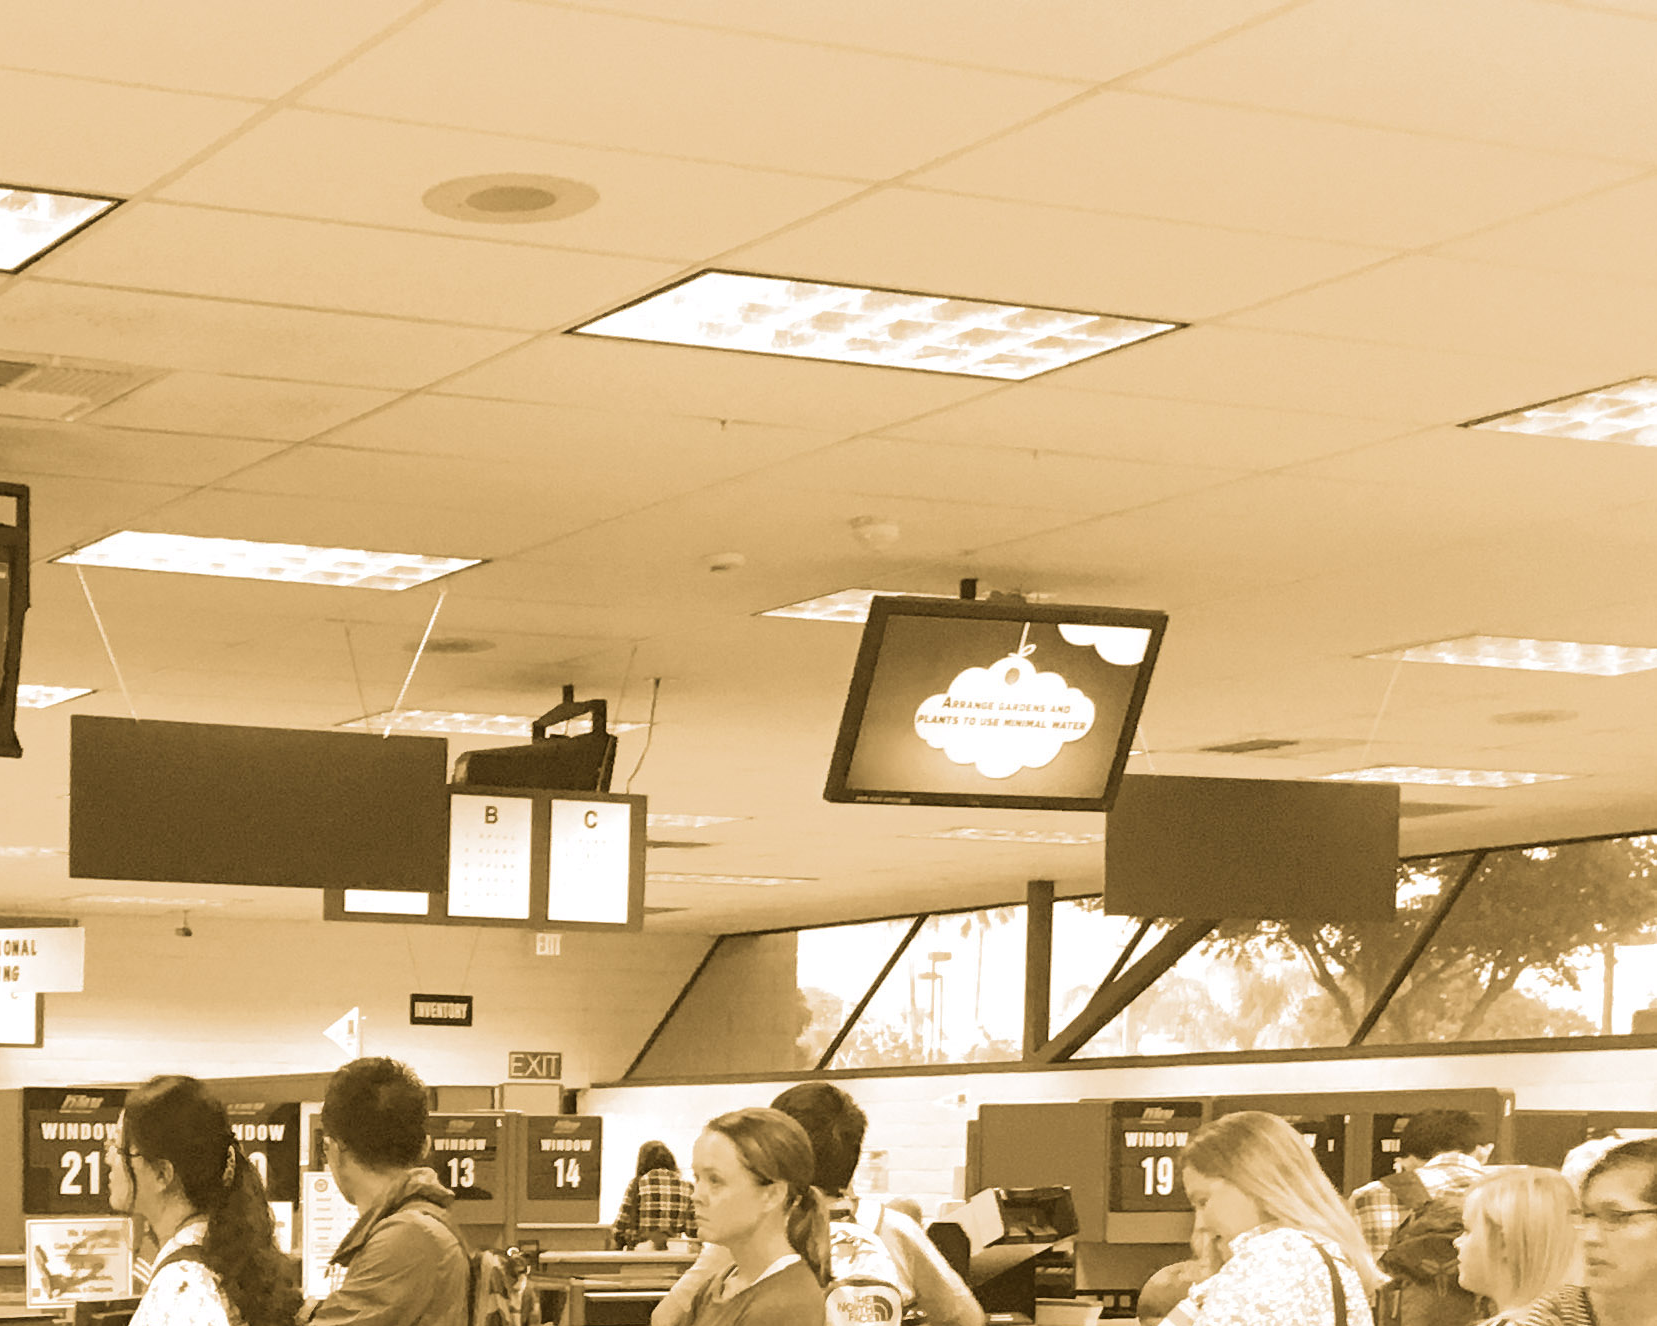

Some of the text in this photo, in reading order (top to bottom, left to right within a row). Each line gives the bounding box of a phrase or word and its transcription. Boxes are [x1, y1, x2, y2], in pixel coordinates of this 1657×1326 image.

[485, 806, 498, 824] B
[584, 810, 598, 829] C
[510, 1054, 560, 1077] EXIT
[434, 1138, 486, 1151] WINDOW
[540, 1139, 592, 1152] WINDOW
[1125, 1132, 1189, 1147] WINDOW
[60, 1151, 100, 1195] 21
[447, 1157, 475, 1188] 13
[553, 1158, 581, 1189] 14
[1141, 1156, 1174, 1195] 19
